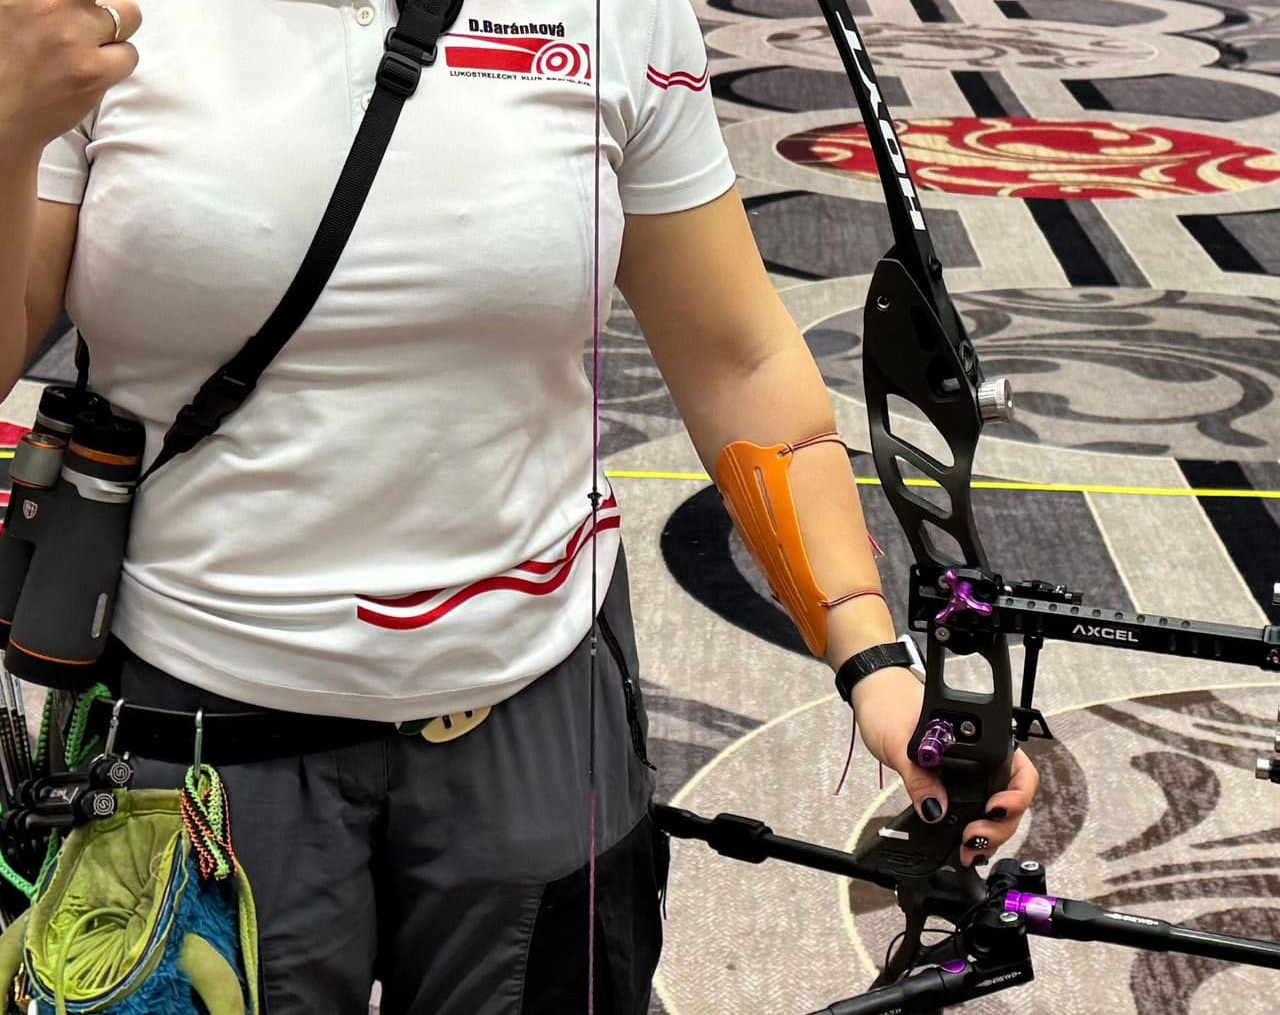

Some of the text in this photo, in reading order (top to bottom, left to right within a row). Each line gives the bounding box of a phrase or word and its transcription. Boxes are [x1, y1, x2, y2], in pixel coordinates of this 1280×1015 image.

[469, 18, 565, 38] D.Baránková
[835, 10, 926, 231] HOYT
[1071, 624, 1140, 643] AXCEL
